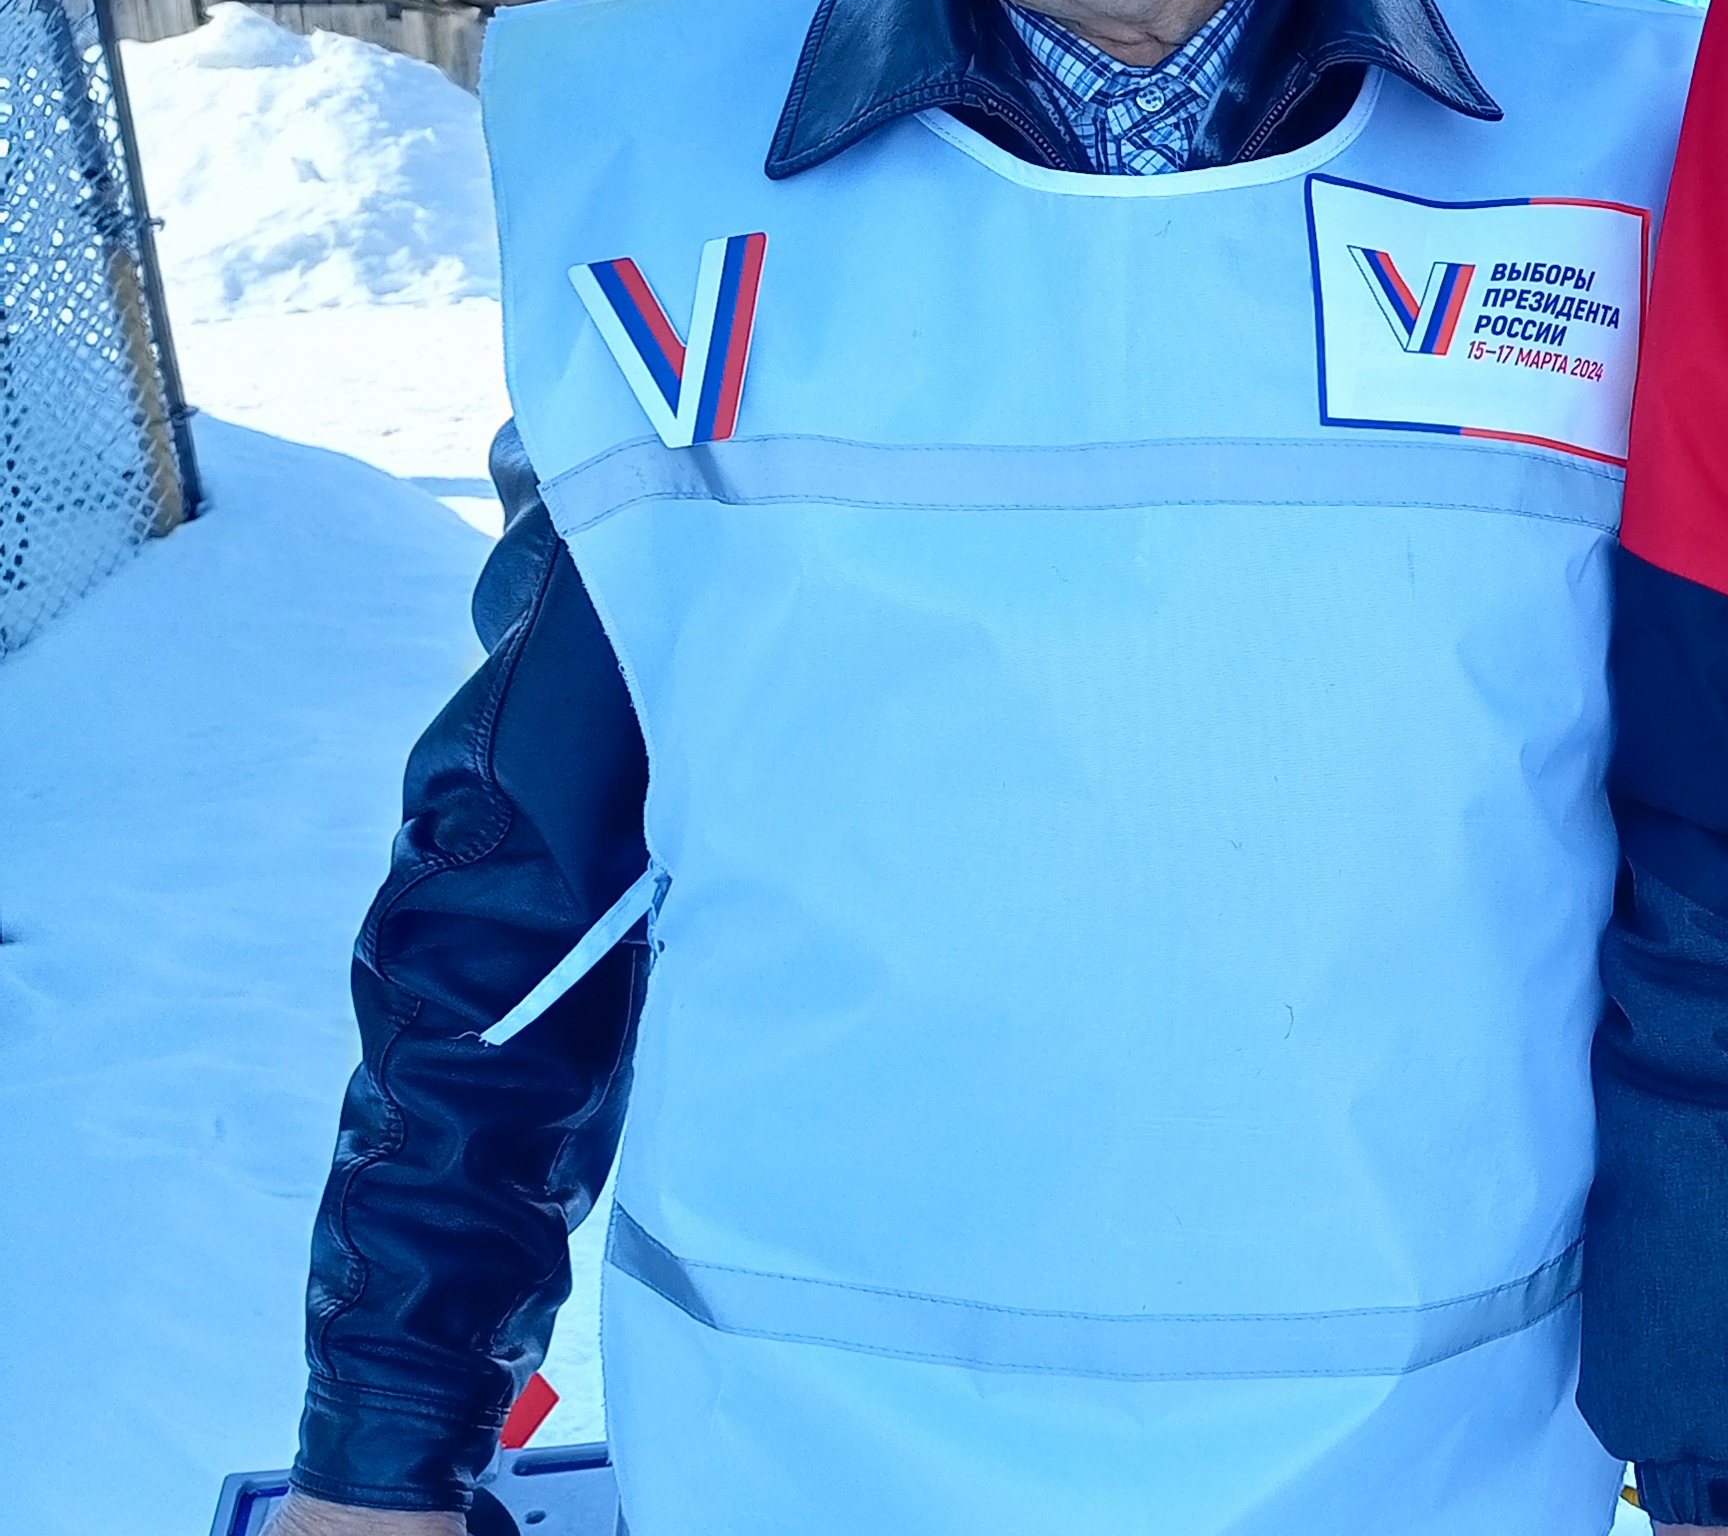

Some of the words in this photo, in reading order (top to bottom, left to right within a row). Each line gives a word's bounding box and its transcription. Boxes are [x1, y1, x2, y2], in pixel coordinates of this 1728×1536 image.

[1491, 262, 1596, 292] ВЫБОРЫ
[1482, 288, 1620, 329] ПРЕЗИДЕНТА
[1474, 314, 1567, 346] РОССИИ
[1515, 352, 1567, 374] МАРТА
[1570, 357, 1604, 382] 2024
